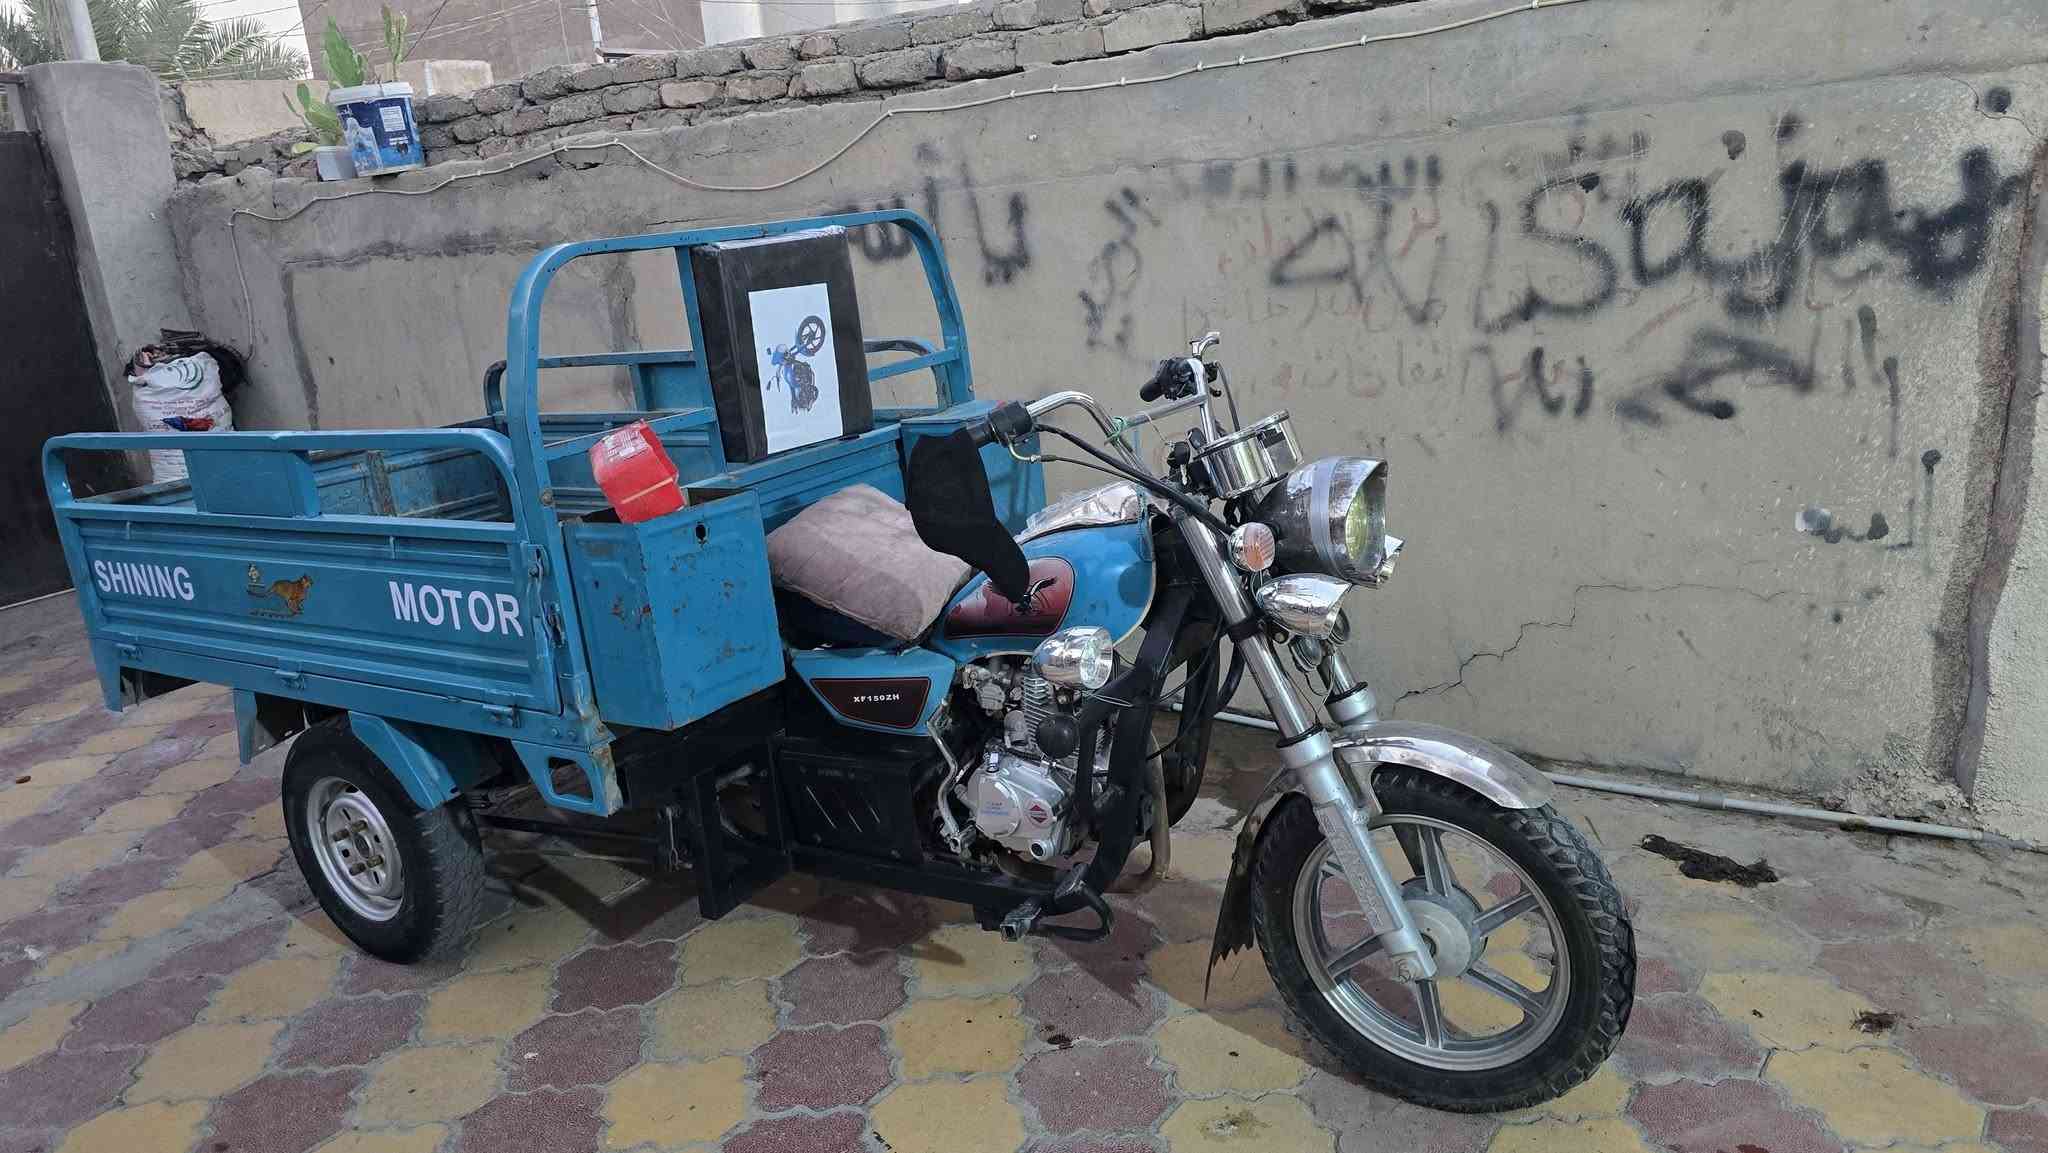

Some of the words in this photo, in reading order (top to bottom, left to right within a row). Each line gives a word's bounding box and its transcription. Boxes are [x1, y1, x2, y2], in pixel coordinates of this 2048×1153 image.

[94, 560, 195, 601] SHINING
[388, 581, 524, 637] MOTOR
[853, 693, 900, 703] XF150ZH
